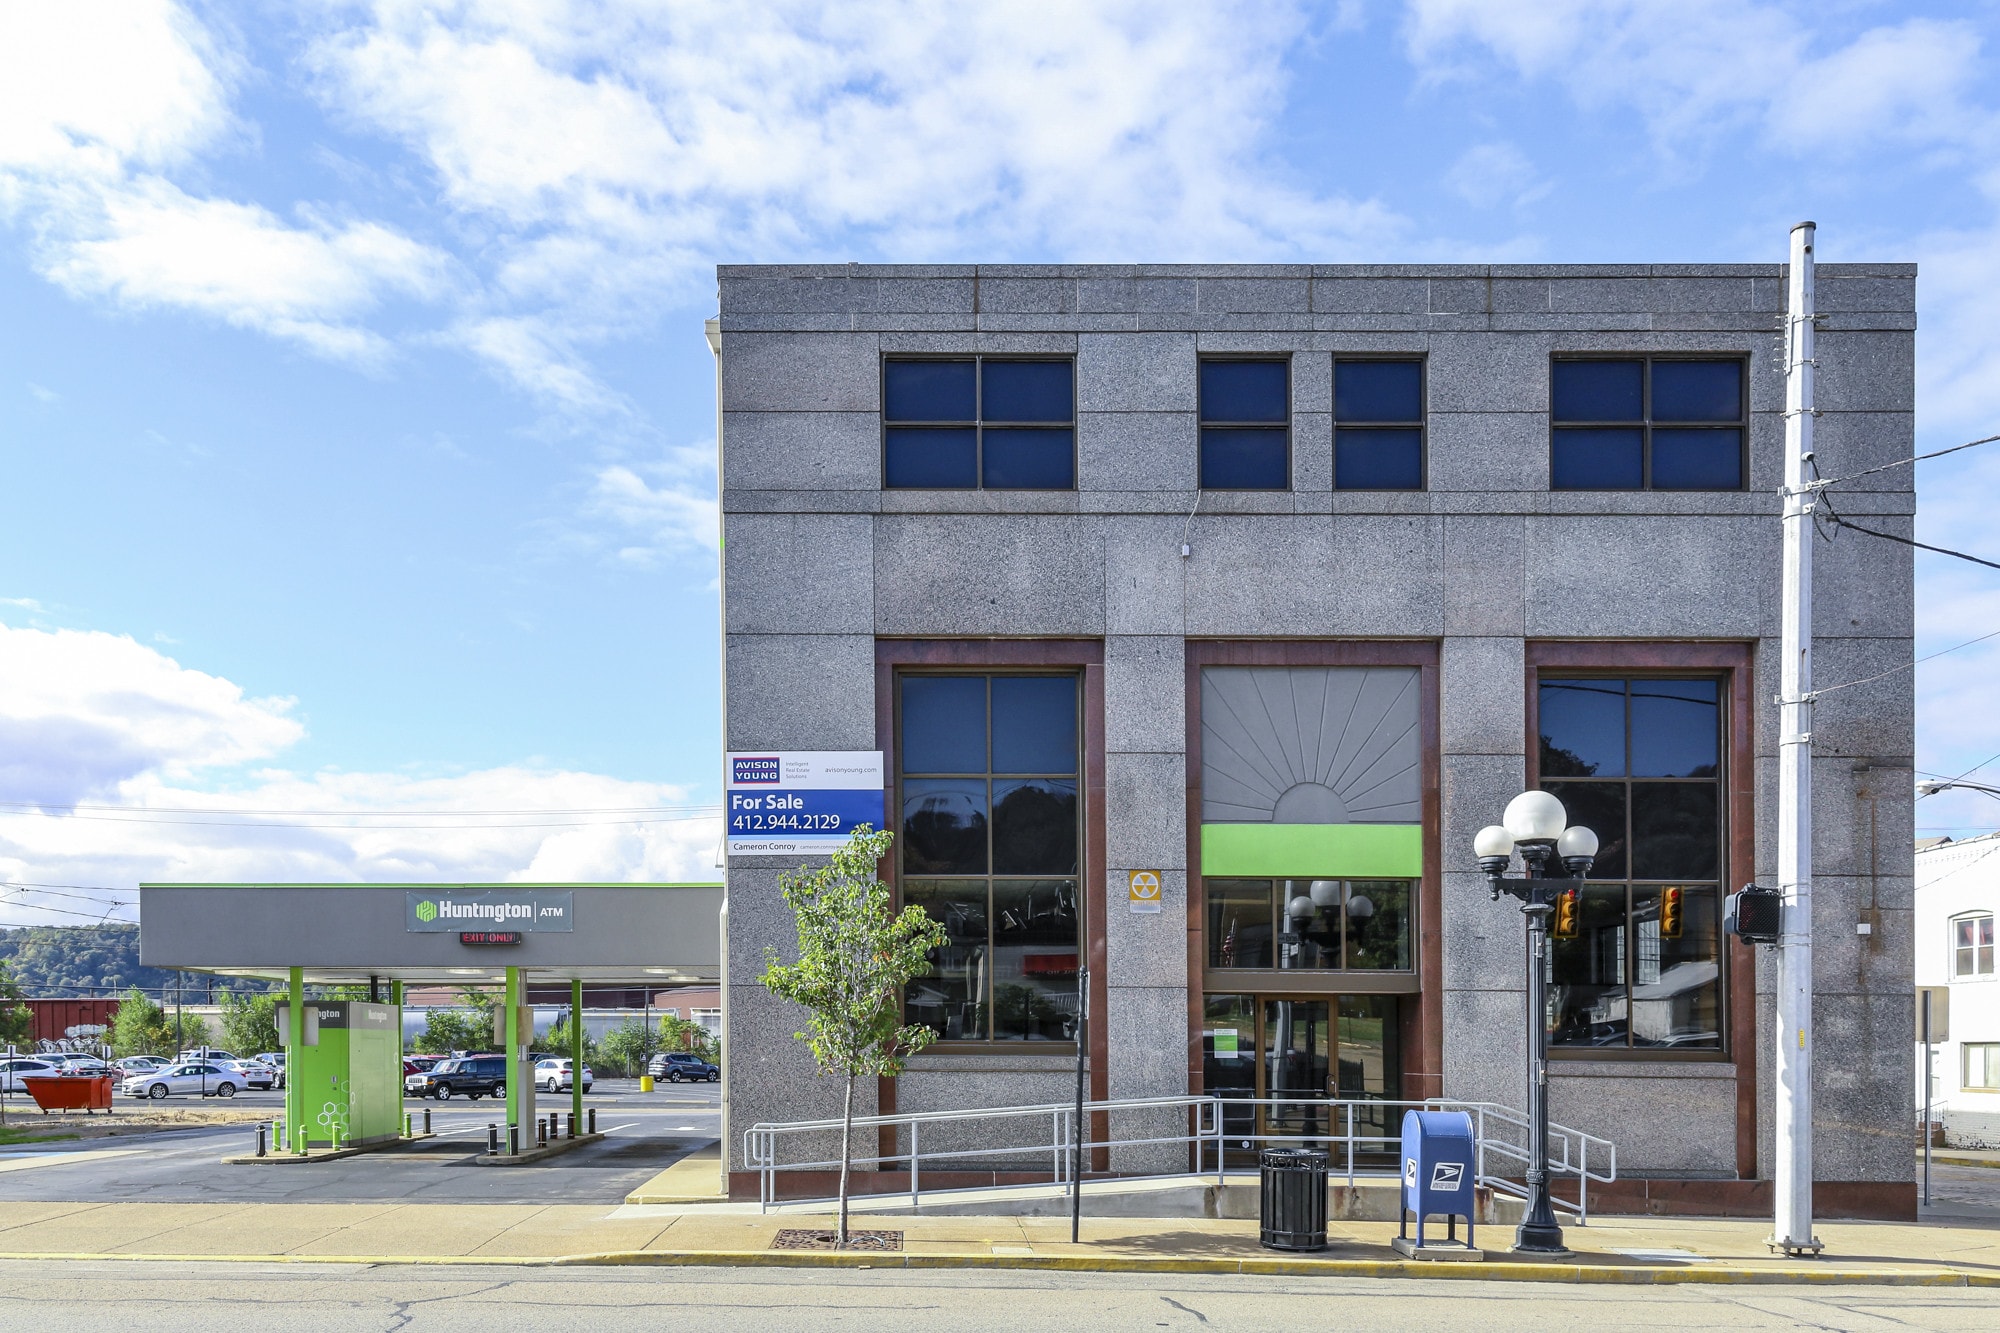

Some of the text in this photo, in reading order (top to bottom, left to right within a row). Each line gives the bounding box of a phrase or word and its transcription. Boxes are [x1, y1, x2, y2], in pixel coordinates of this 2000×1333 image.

[736, 761, 777, 769] AVISON
[736, 772, 777, 780] YOUNG
[732, 794, 804, 810] For Sale
[733, 814, 840, 830] 412.944.2129
[733, 843, 796, 851] Cameron Conroy
[440, 901, 563, 923] Huntington ATM
[463, 933, 513, 942] EXIT ONLY
